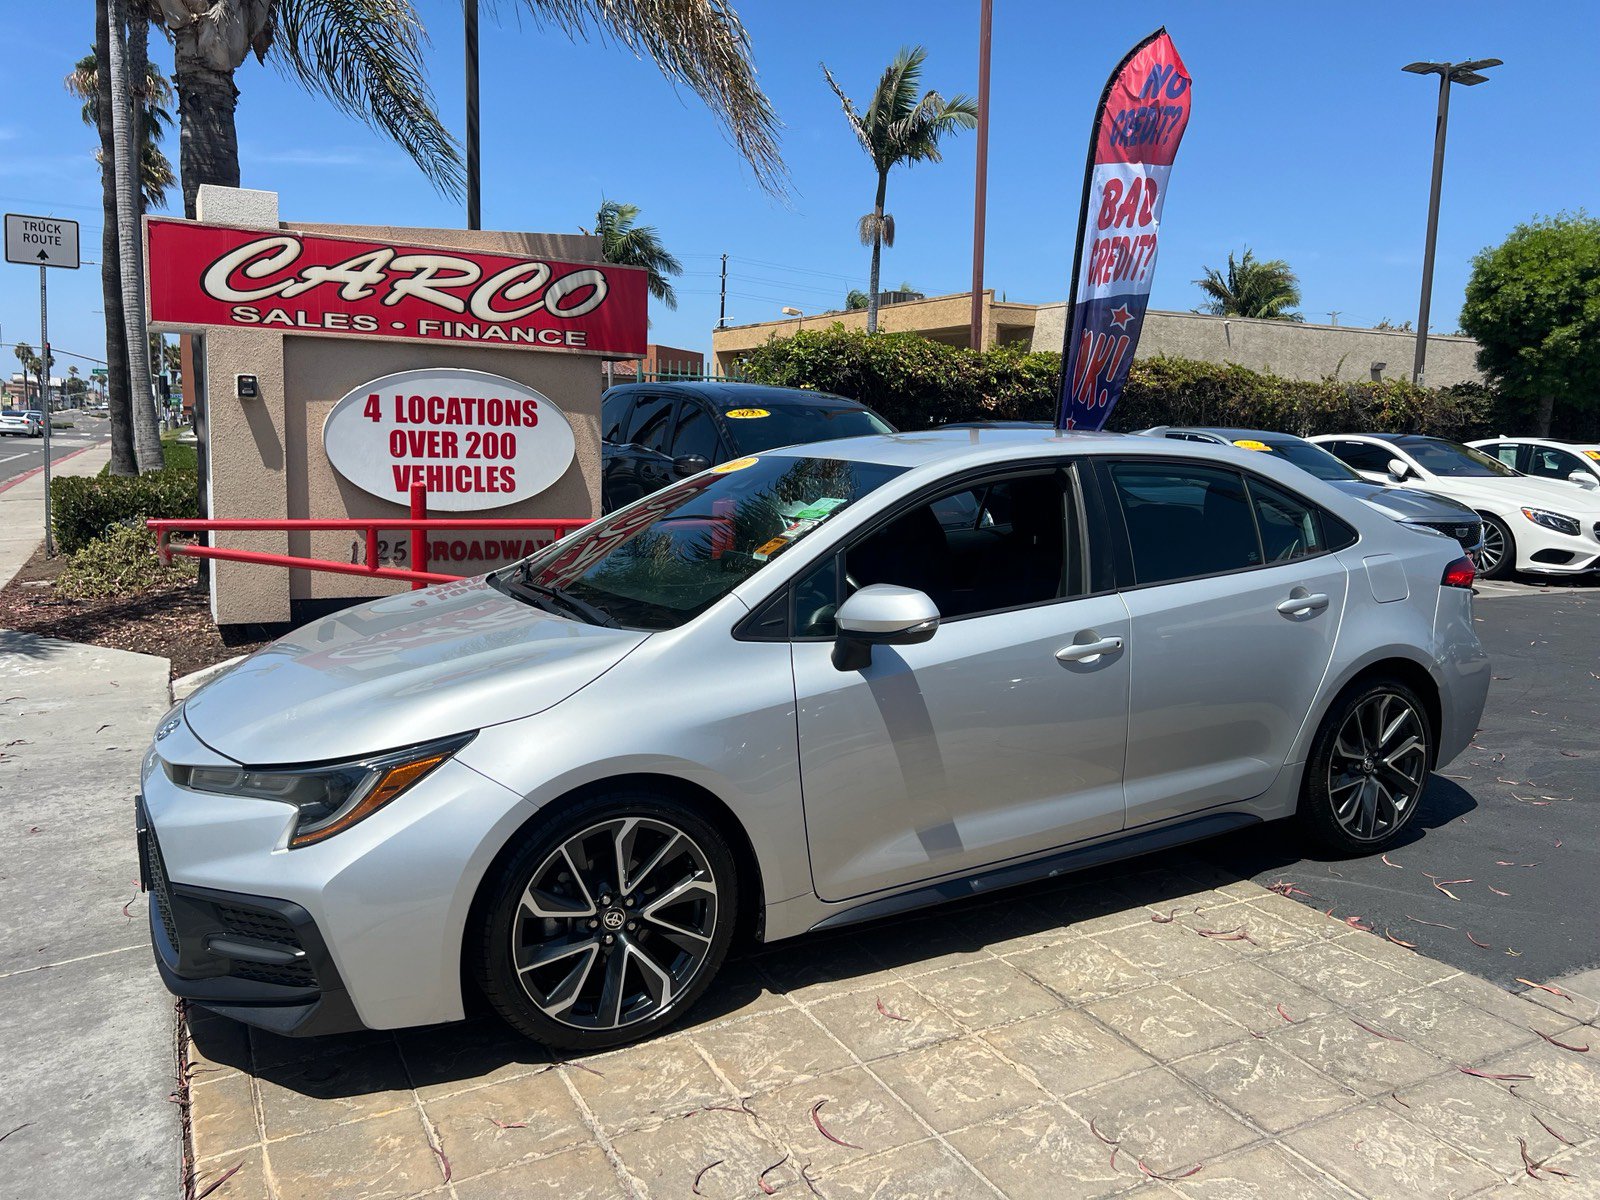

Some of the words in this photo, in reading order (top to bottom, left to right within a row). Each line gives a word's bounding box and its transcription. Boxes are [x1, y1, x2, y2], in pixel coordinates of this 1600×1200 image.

[1109, 105, 1183, 148] CREDIT?
[1097, 176, 1158, 230] BAD
[23, 220, 62, 235] TRUCK
[23, 232, 62, 246] ROUTE
[1087, 233, 1158, 288] CREDIT?
[202, 235, 609, 322] CARCO
[232, 306, 378, 332] SALES
[418, 320, 588, 347] FINANCE
[363, 394, 382, 423] 4
[395, 394, 539, 427] LOCATIONS
[389, 429, 458, 459] OVER
[465, 431, 517, 460] 200
[392, 464, 516, 494] VEHICLES
[350, 540, 408, 565] 125
